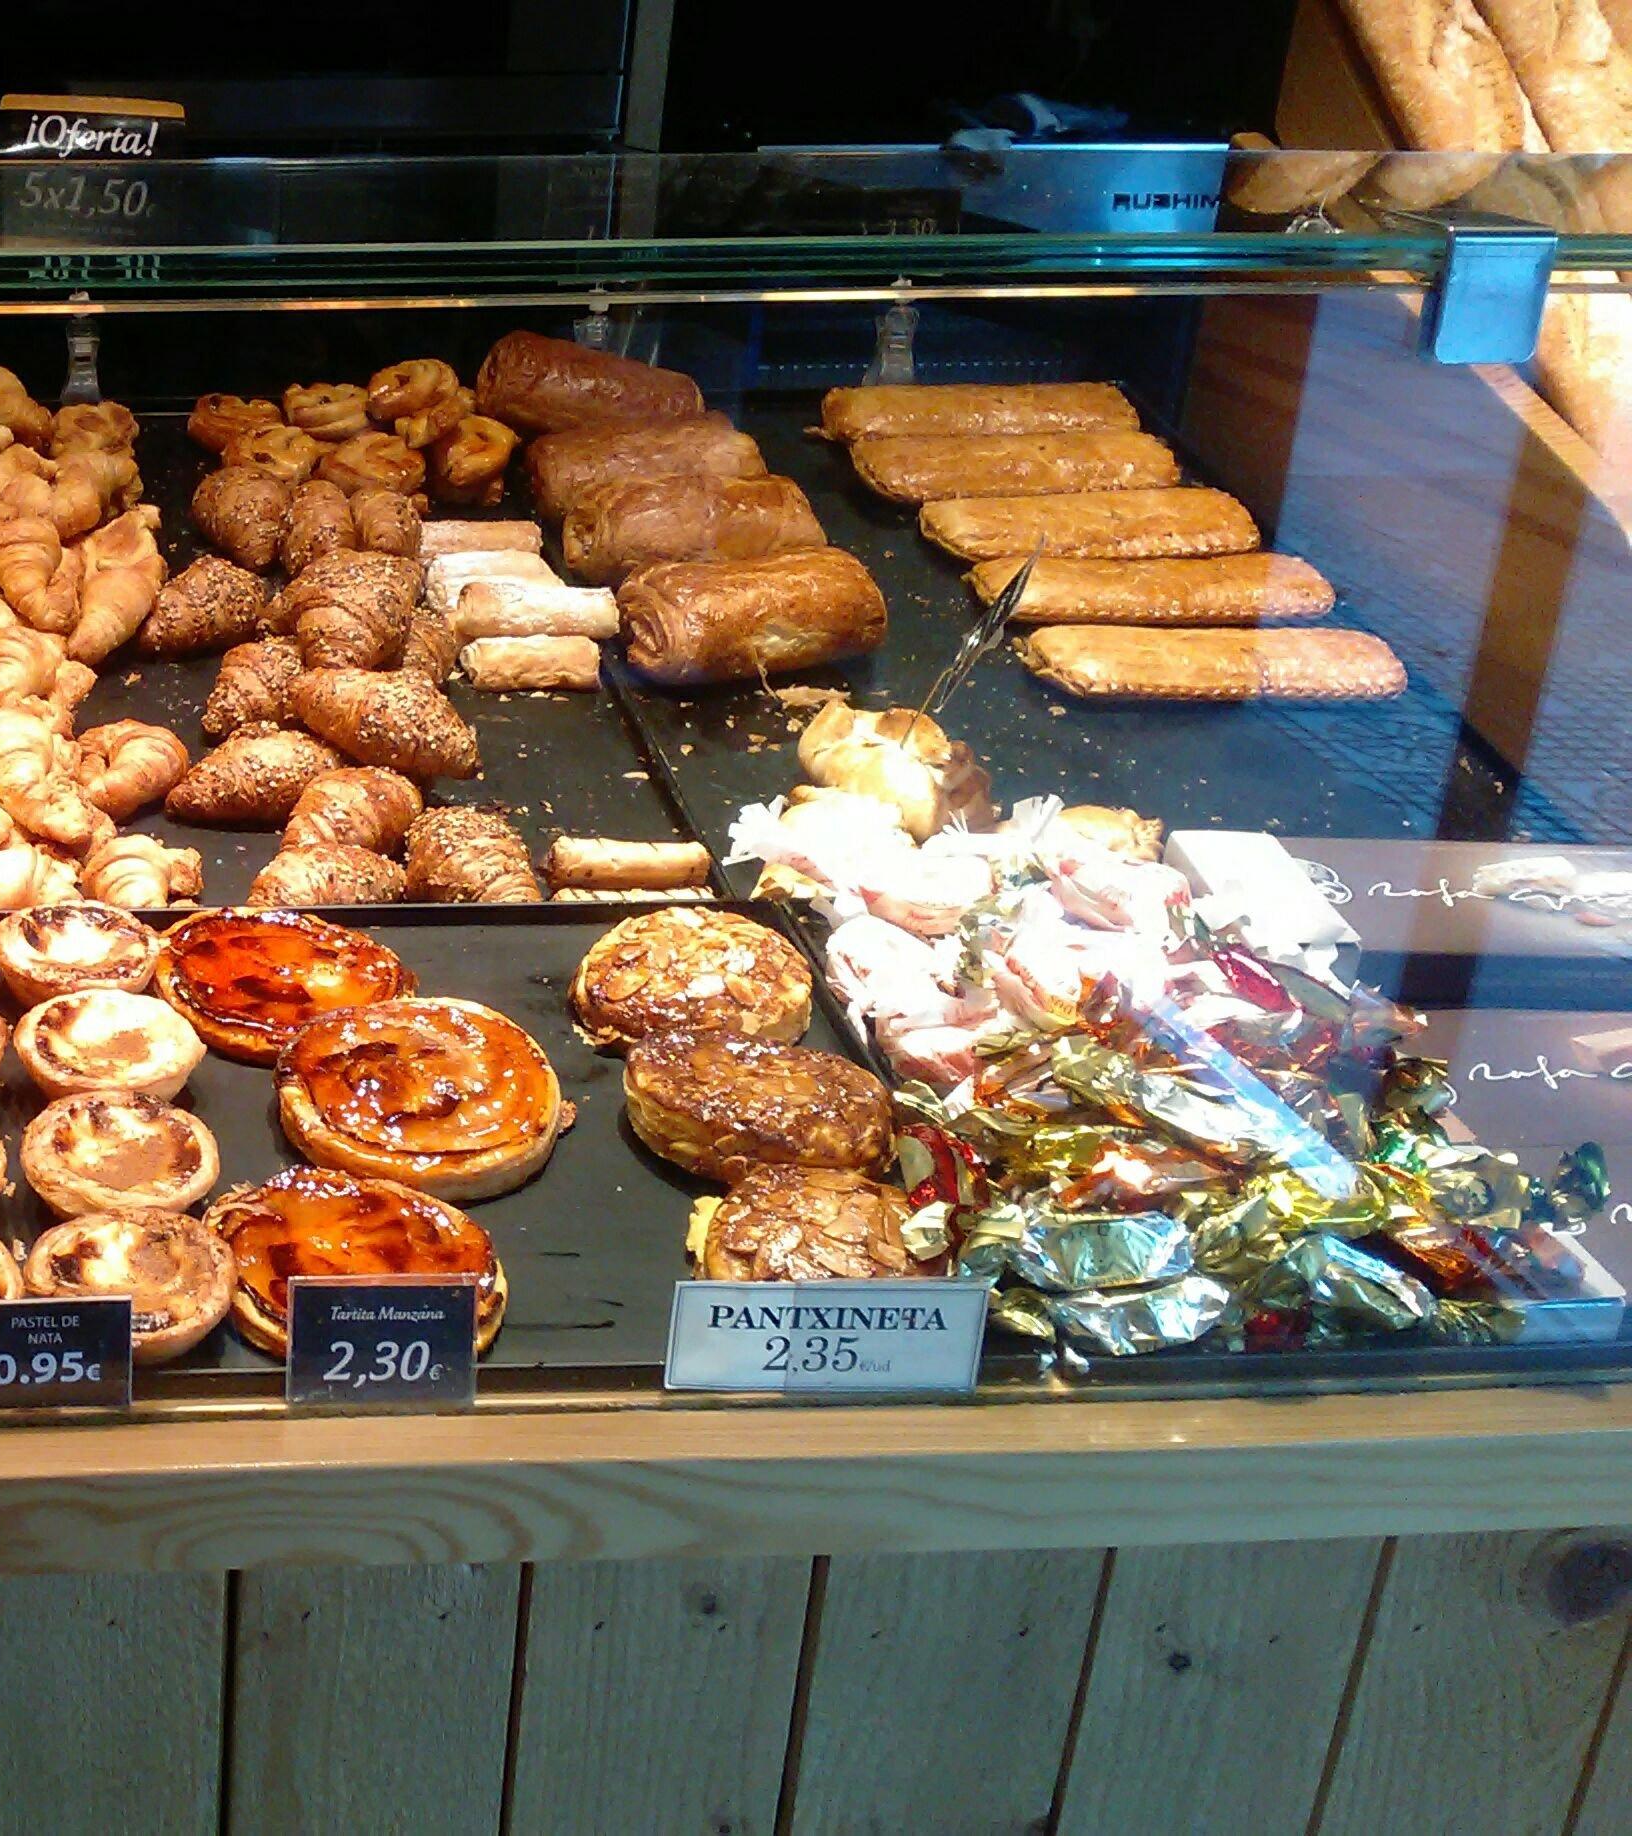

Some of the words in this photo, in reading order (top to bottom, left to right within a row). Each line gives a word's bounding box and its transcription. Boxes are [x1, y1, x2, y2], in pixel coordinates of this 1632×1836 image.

[24, 114, 159, 158] ¡Oferta!
[10, 1315, 59, 1329] PASTEL
[61, 1315, 80, 1328] DE
[330, 1305, 376, 1321] Tartita
[707, 1303, 948, 1331] PANTXINETA
[27, 1332, 63, 1345] NATA
[323, 1340, 444, 1388] 2,30€
